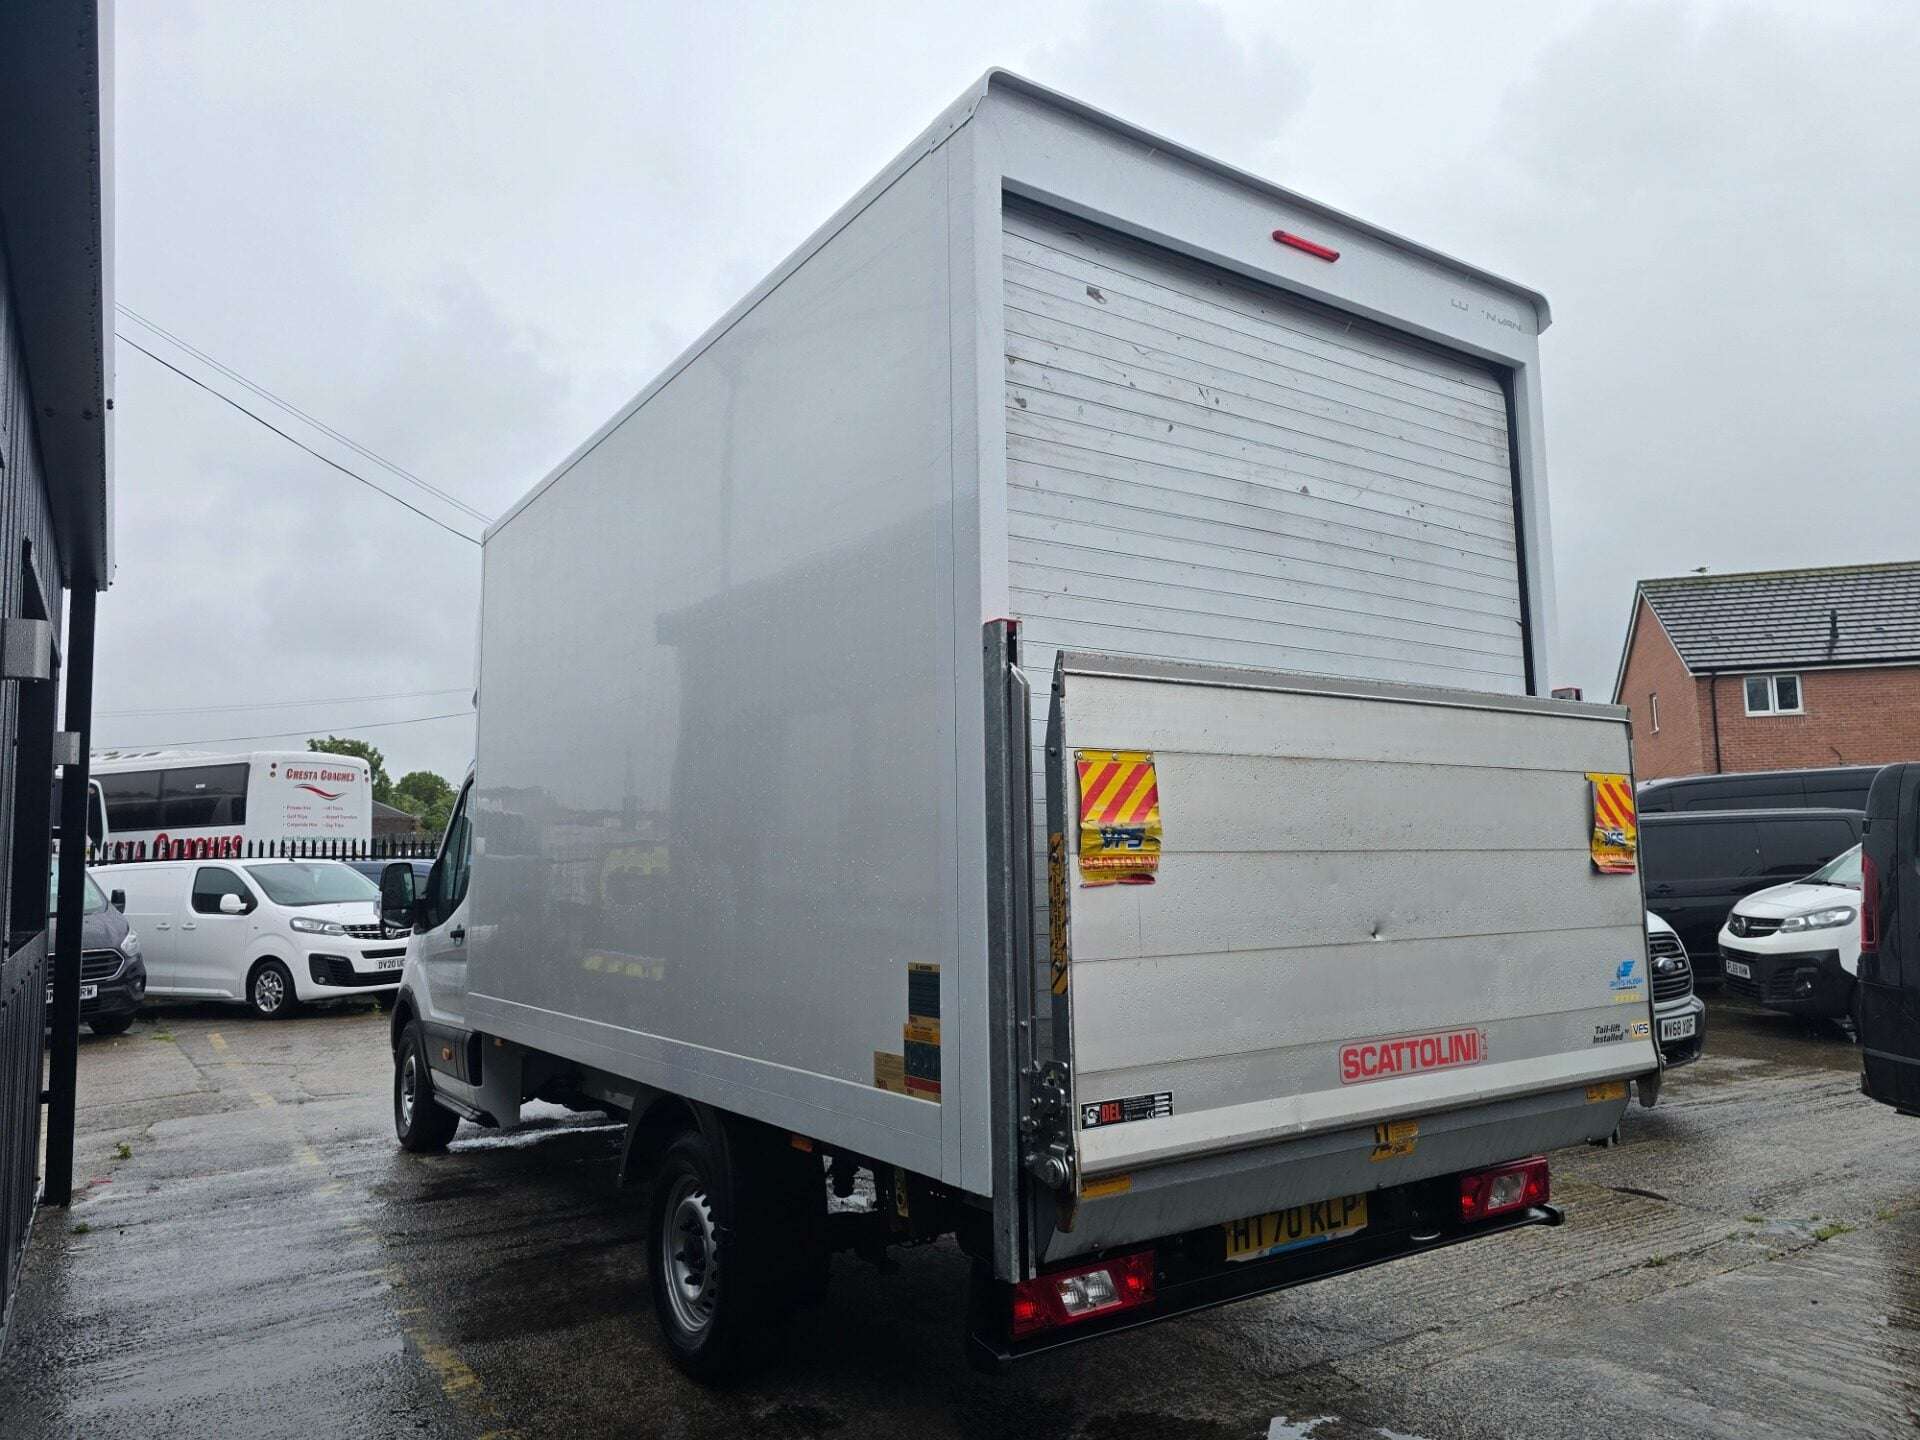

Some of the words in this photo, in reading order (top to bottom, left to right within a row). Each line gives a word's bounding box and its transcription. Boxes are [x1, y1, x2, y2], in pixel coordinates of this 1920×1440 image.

[1593, 1033, 1624, 1044] Installed
[1594, 1024, 1621, 1035] Tail-lift
[1343, 1033, 1478, 1080] SCATTOLINI
[1308, 1194, 1362, 1235] KLP
